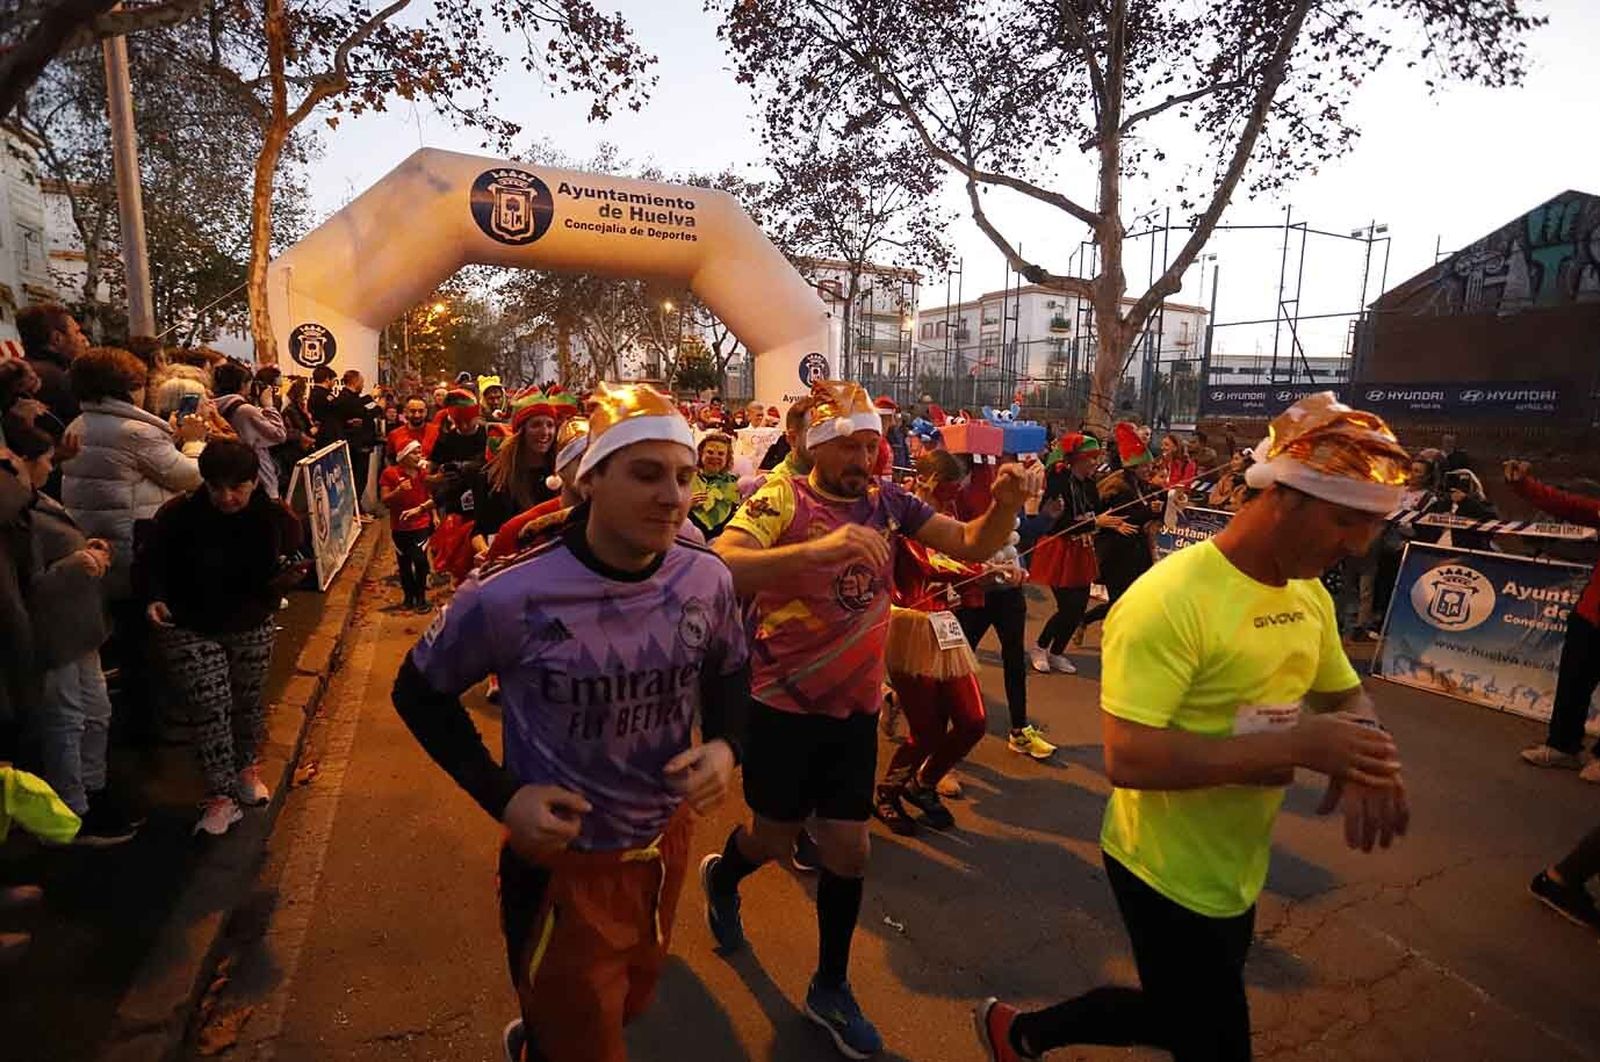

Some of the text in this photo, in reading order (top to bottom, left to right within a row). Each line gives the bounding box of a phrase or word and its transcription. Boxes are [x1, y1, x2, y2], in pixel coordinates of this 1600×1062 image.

[558, 182, 695, 211] Ayuntamiento
[598, 203, 695, 227] de Huelva
[629, 225, 644, 236] de
[648, 227, 698, 242] Deportes
[1226, 391, 1266, 400] HYUNDAI
[1387, 390, 1445, 400] HYUNDAI
[1487, 390, 1557, 401] HYUNDAI
